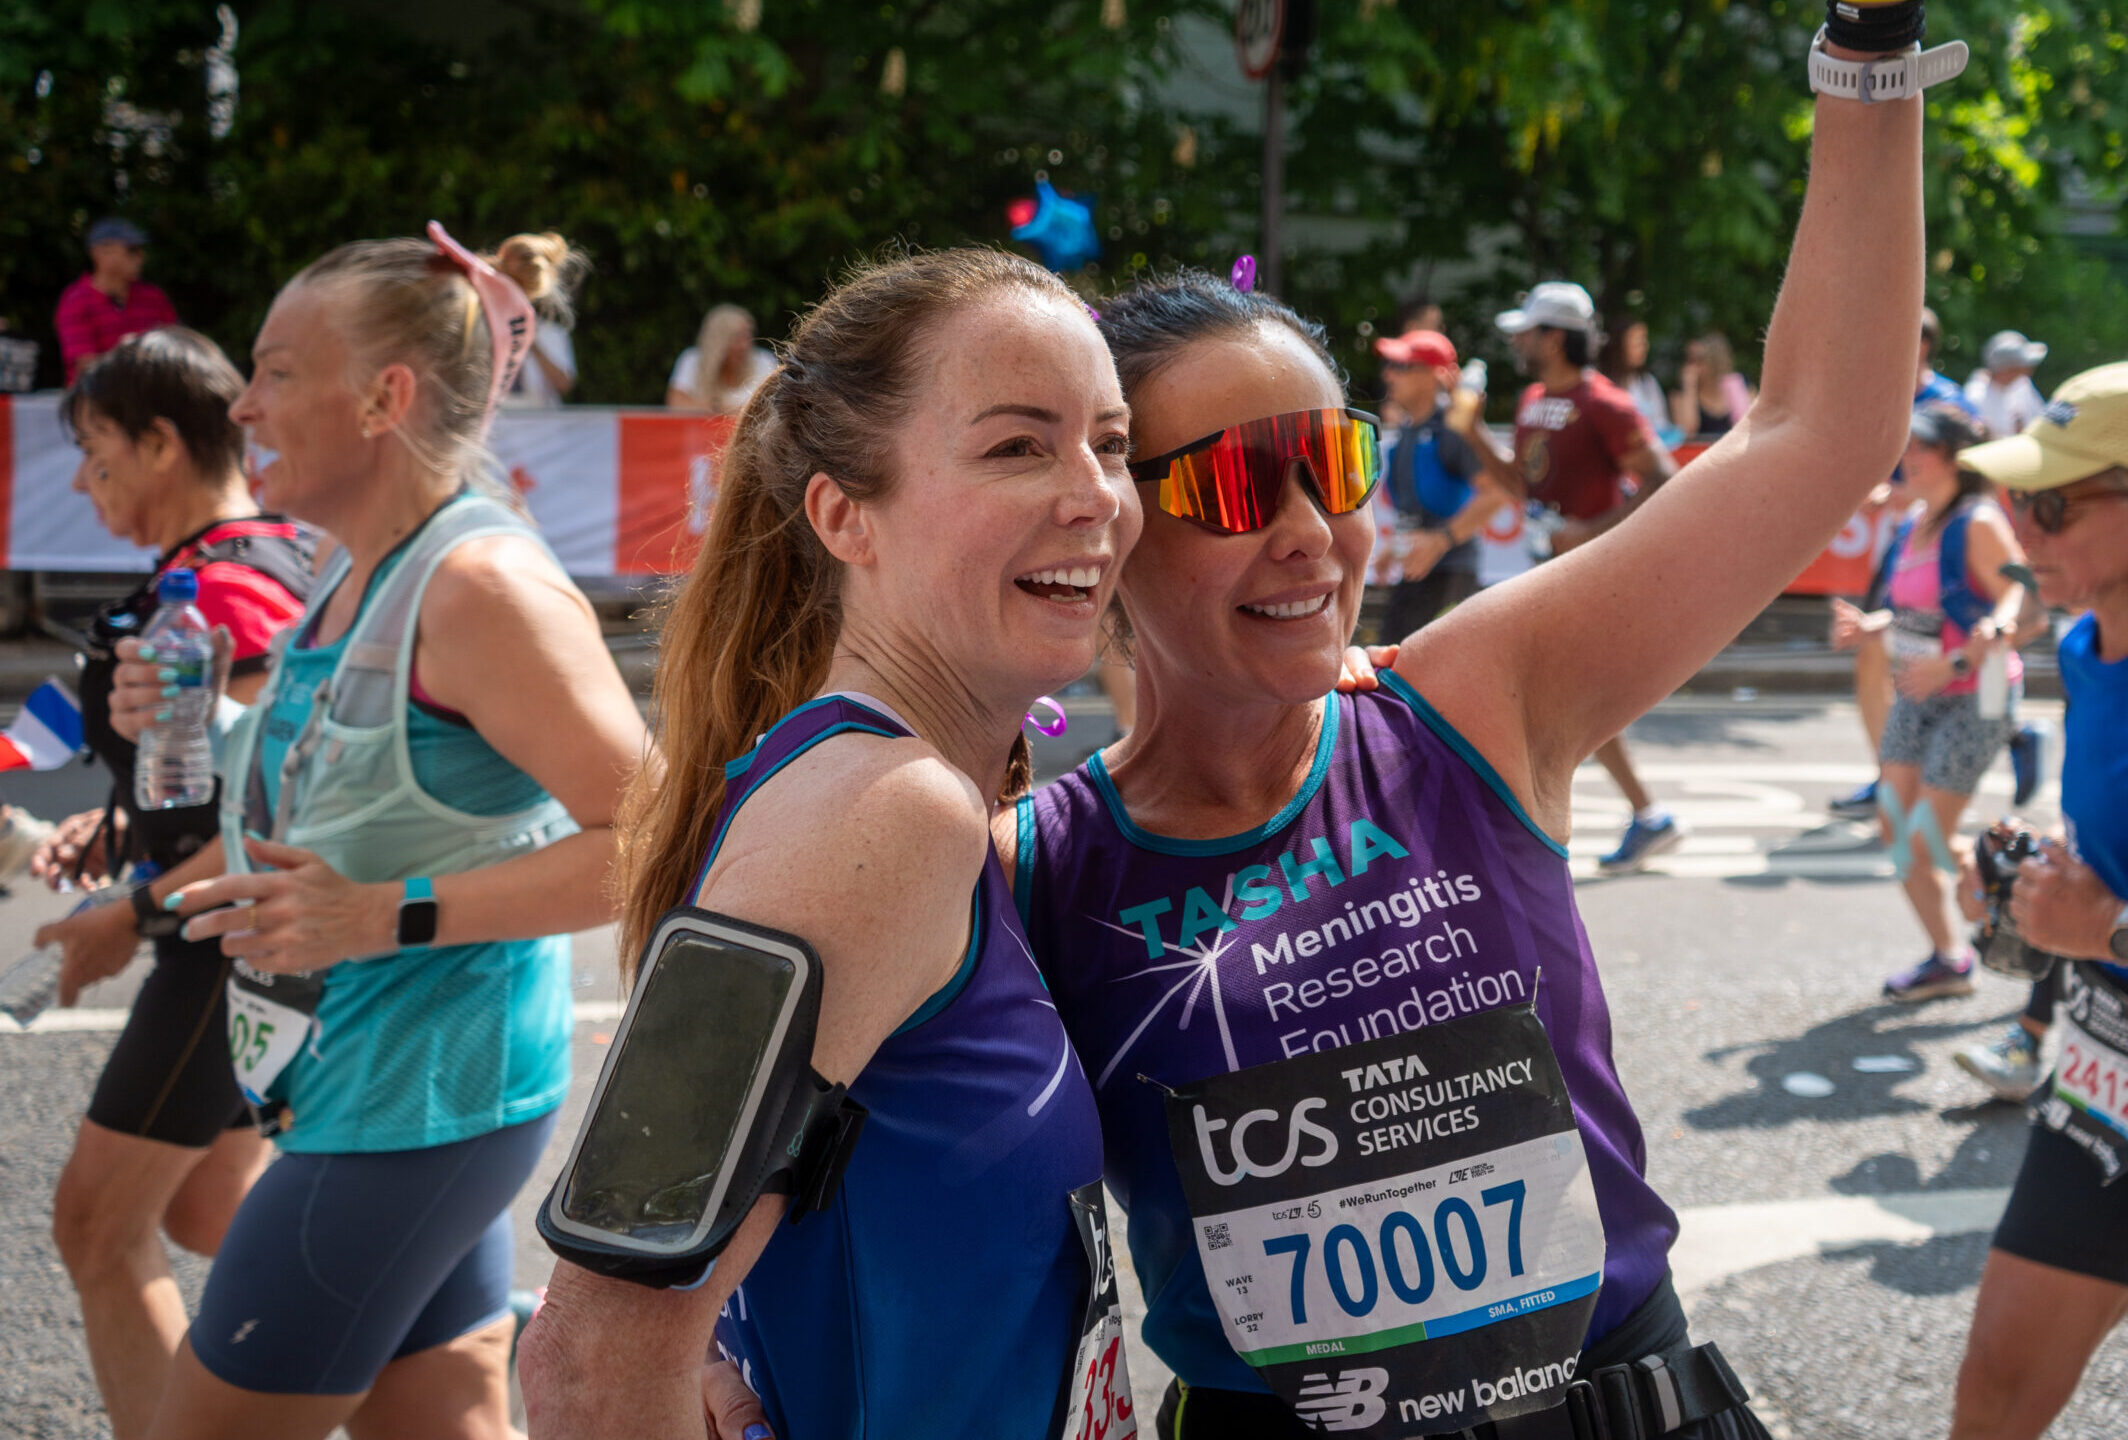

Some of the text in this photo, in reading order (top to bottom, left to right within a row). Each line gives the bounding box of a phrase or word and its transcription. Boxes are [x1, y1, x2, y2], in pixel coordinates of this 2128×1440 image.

[1119, 818, 1409, 960] TASHA
[1251, 870, 1482, 976] Meningitis
[1263, 922, 1478, 1023] Research
[1341, 1054, 1429, 1093] TATA
[1350, 1058, 1533, 1124] CONSULTANCY
[1193, 1097, 1339, 1186] tcs
[1356, 1105, 1480, 1156] SERVICES
[1339, 1179, 1437, 1209] #WeRunTogether
[1263, 1179, 1527, 1325] 70007
[1226, 1275, 1253, 1287] WAVE
[1237, 1287, 1249, 1295] 13
[1235, 1312, 1264, 1325] LORRY
[1488, 1291, 1556, 1318] SMA, FITTED
[1247, 1324, 1259, 1333] 32
[1305, 1341, 1346, 1355] MEDAL
[1399, 1388, 1465, 1423] new
[1471, 1350, 1582, 1405] balanc
